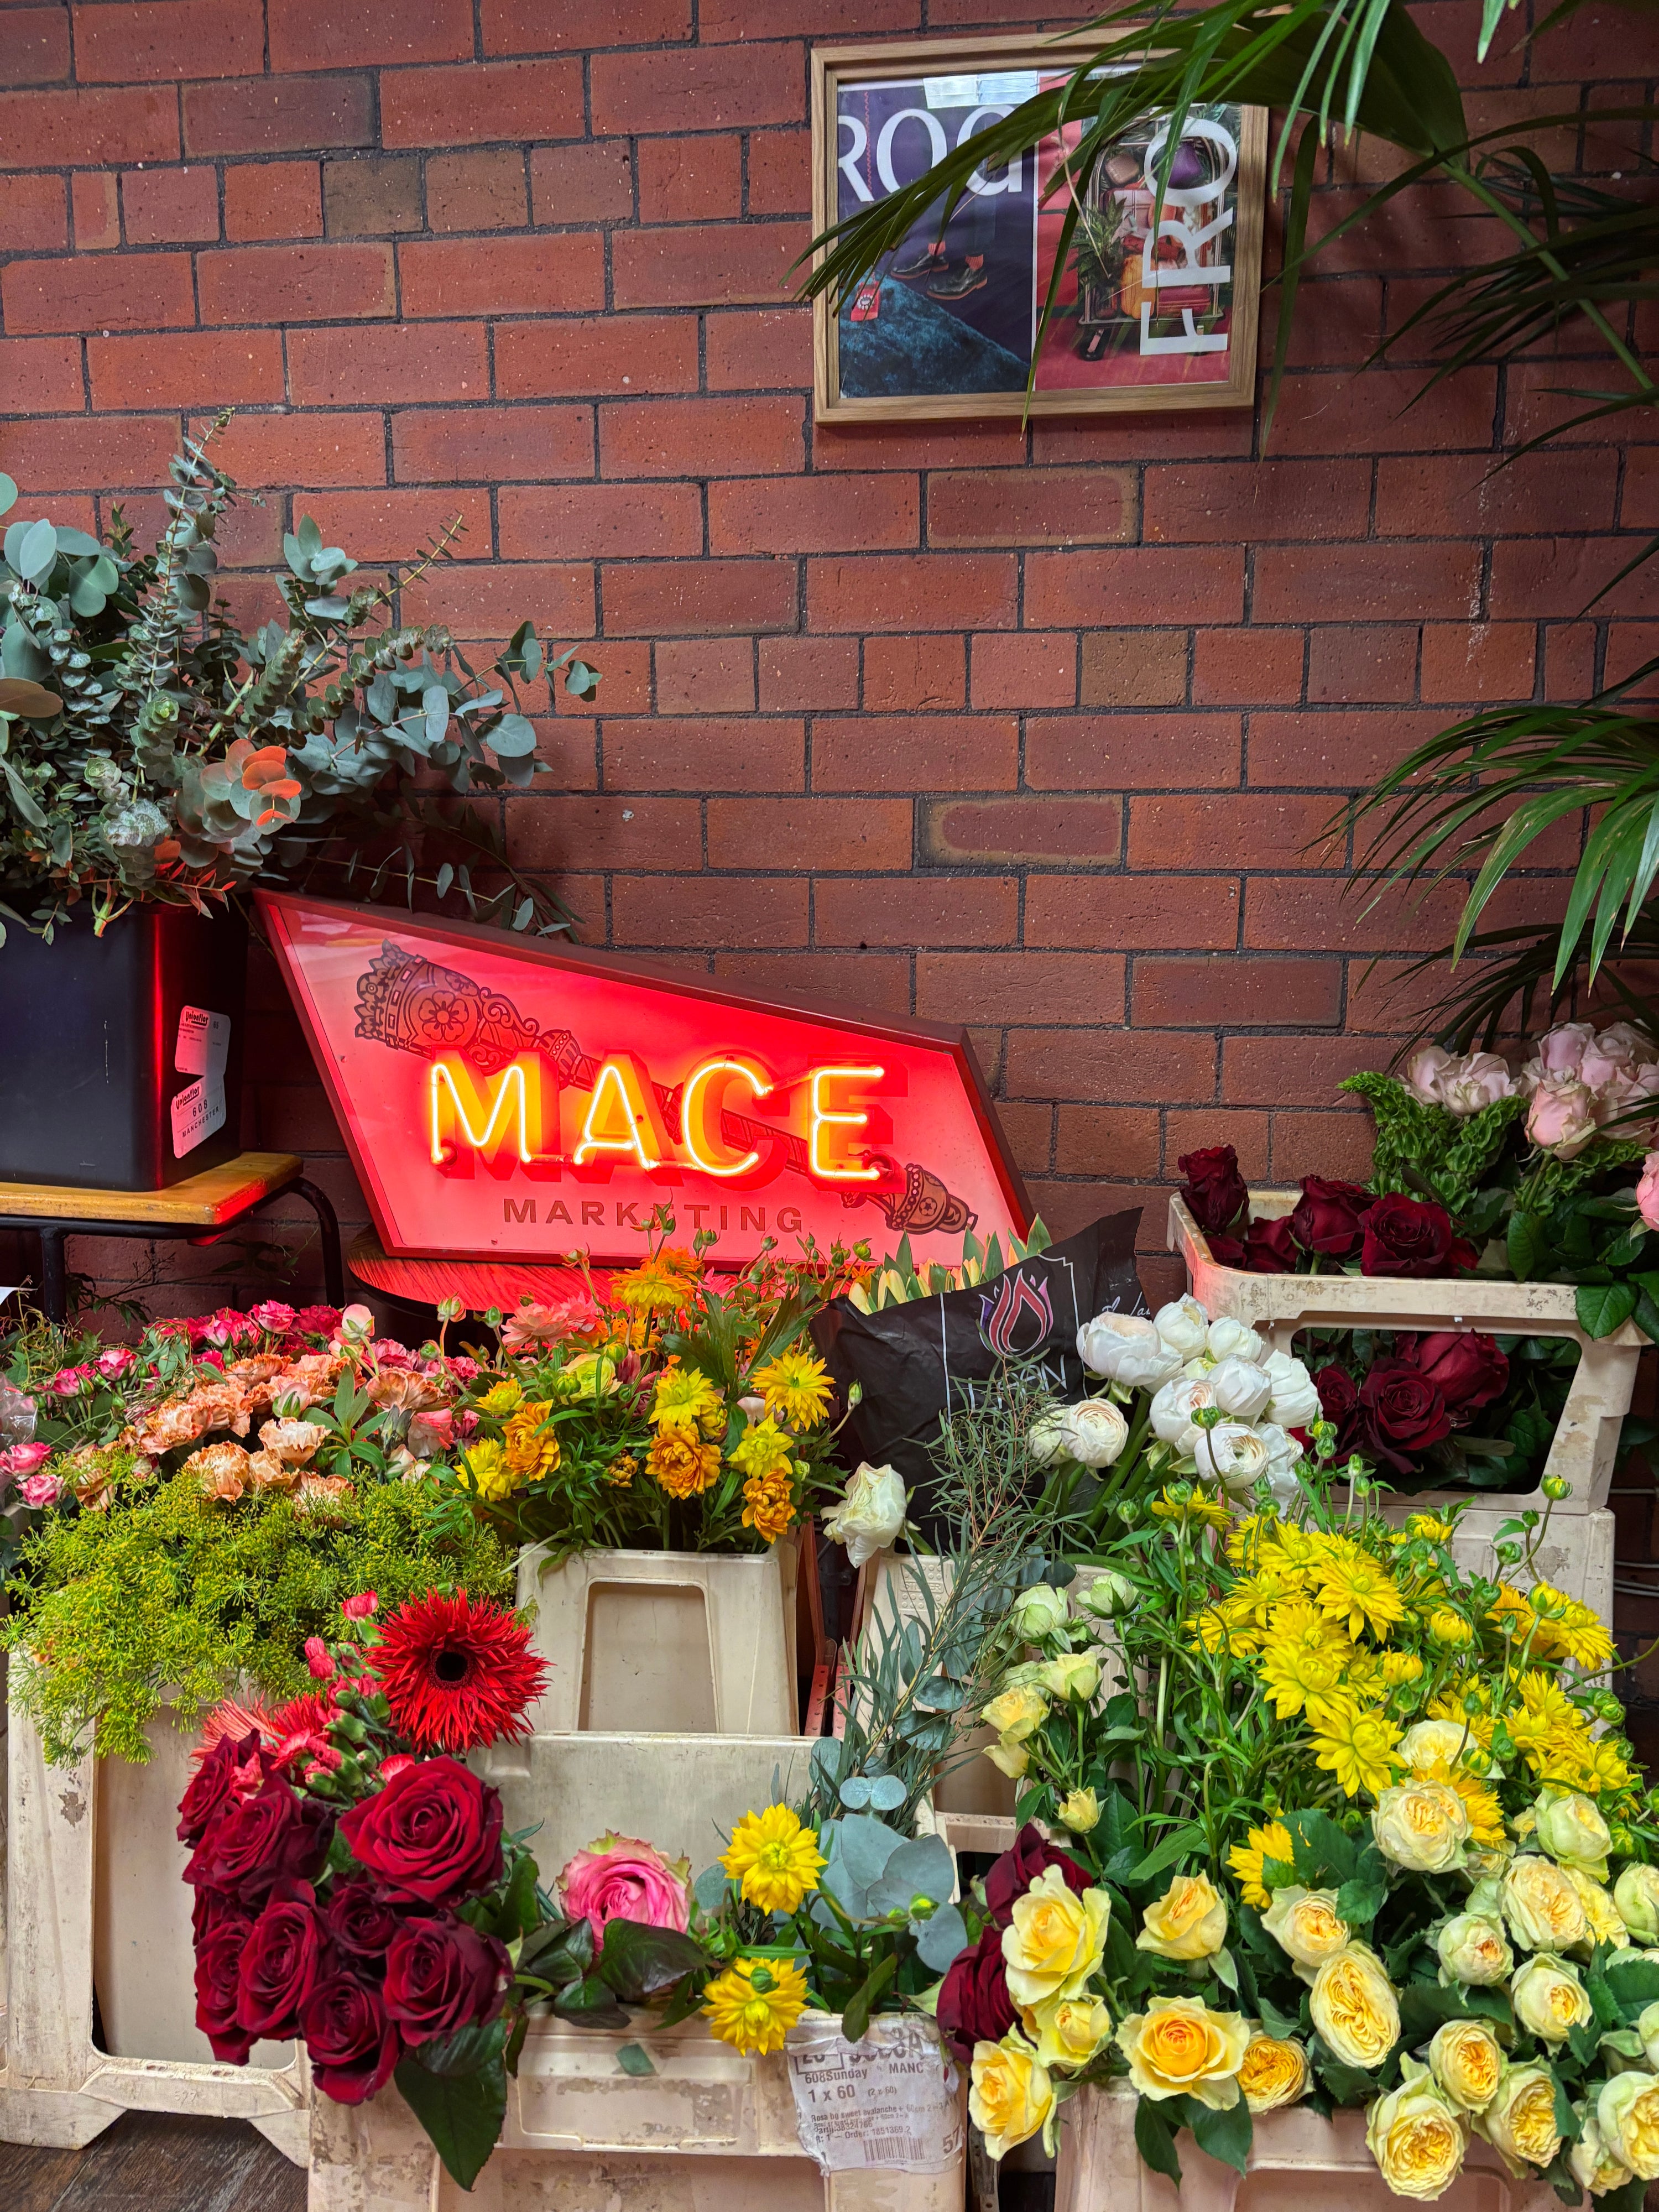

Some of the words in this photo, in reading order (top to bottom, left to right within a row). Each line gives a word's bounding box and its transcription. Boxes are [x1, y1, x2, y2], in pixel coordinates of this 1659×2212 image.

[185, 1010, 208, 1025] Unionflor
[176, 1086, 200, 1110] Unionflor
[192, 1099, 208, 1117] 608
[182, 1106, 220, 1138] MANCHESTER
[429, 1050, 895, 1186] MACE
[805, 2069, 868, 2084] 608Sunday
[808, 2089, 816, 2103] 1
[824, 2091, 832, 2101] x
[837, 2084, 855, 2099] 60
[811, 2114, 828, 2122] Rosa
[841, 2109, 860, 2119] sweet
[863, 2105, 897, 2116] avalanche
[845, 2130, 869, 2139] Order:
